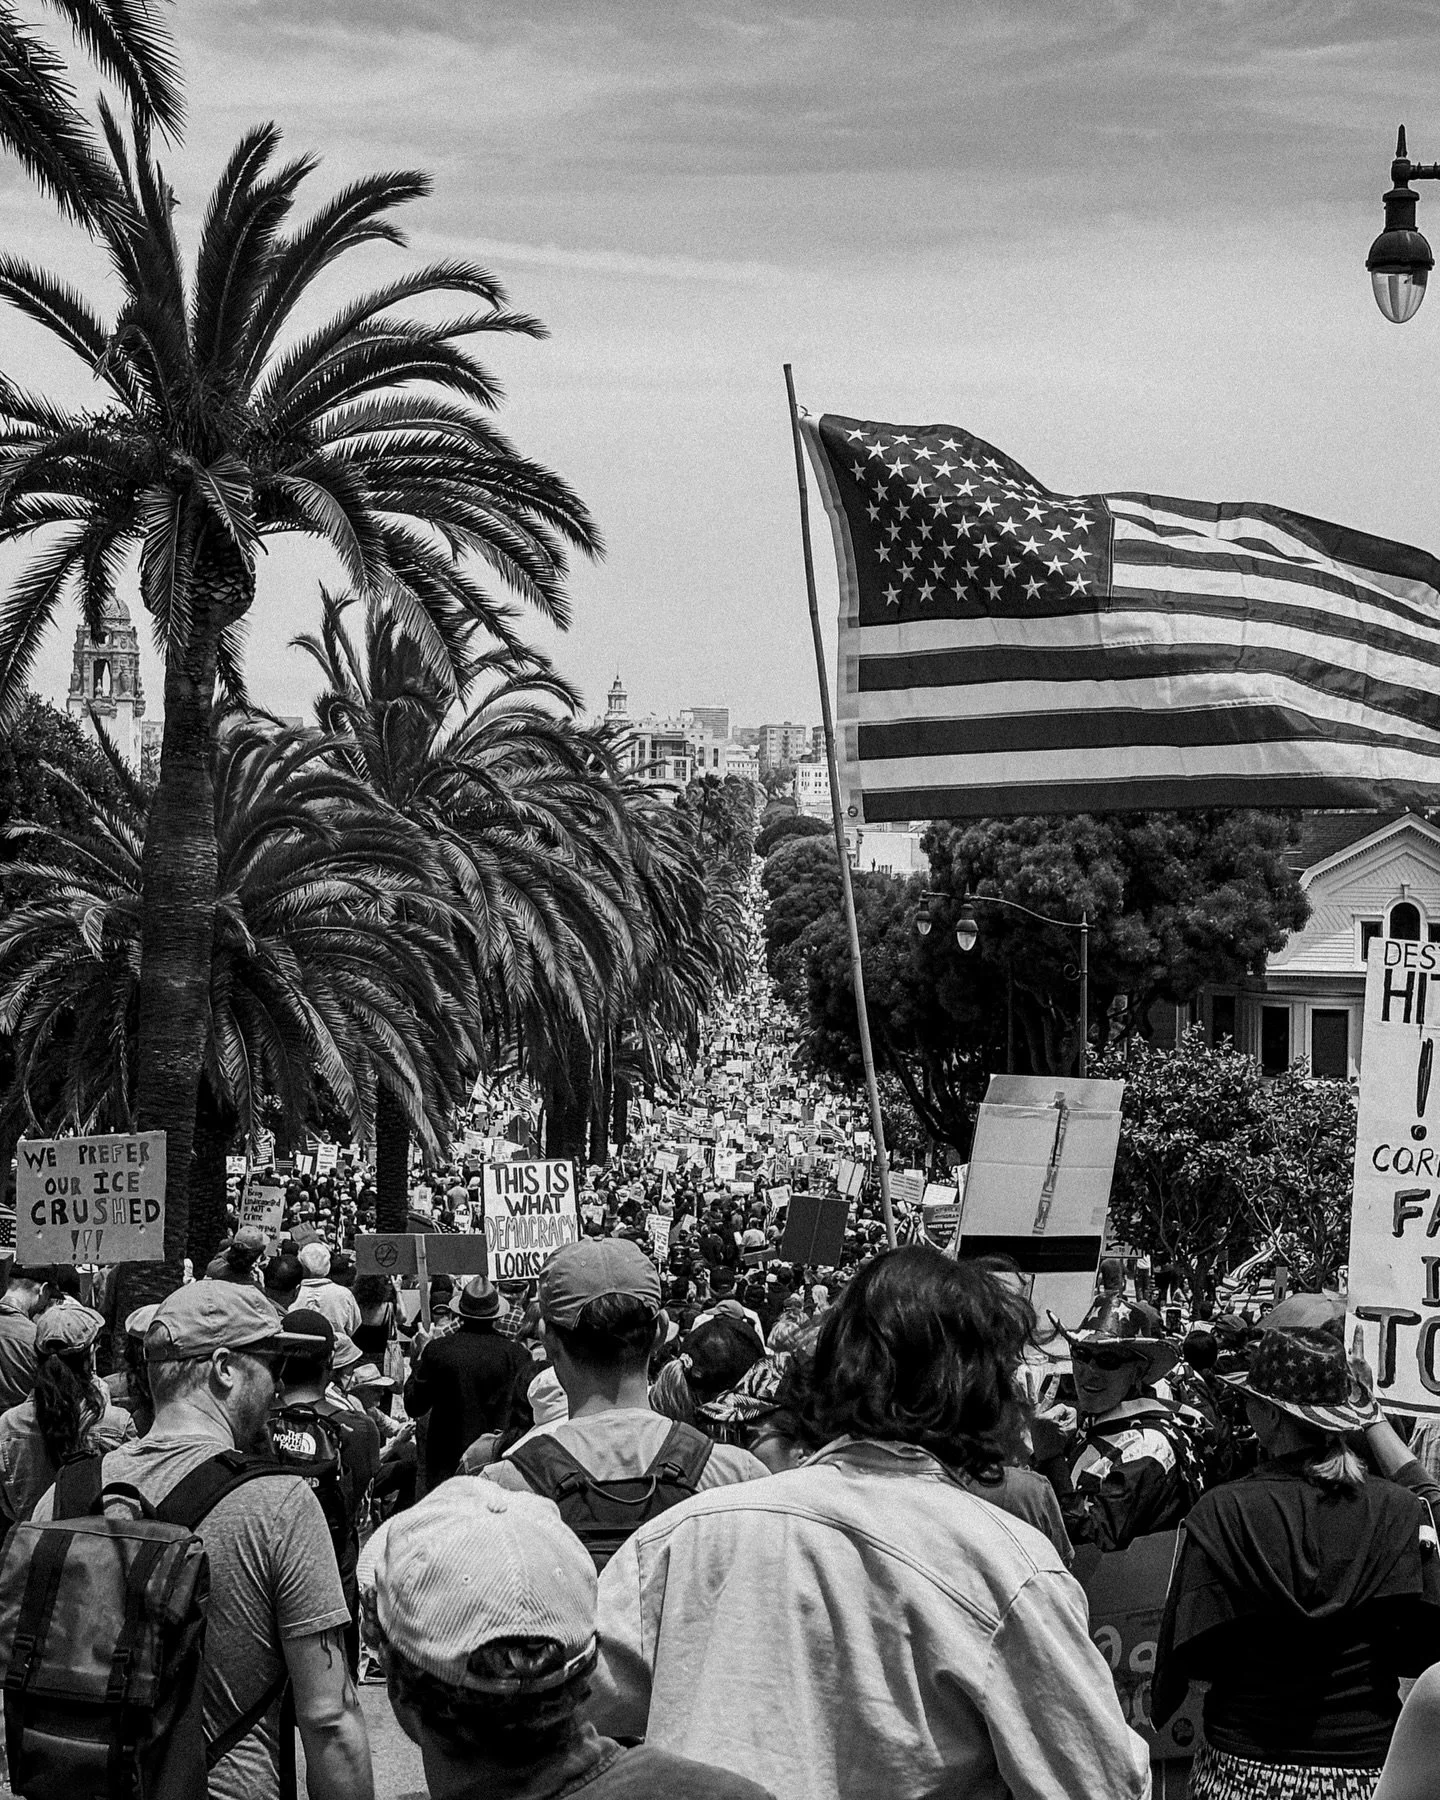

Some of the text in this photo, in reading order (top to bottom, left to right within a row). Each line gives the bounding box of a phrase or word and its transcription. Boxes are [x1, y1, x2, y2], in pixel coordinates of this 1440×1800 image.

[1384, 941, 1440, 970] DES
[23, 1141, 150, 1172] WE PREFER
[1372, 1143, 1440, 1177] COR
[44, 1170, 140, 1196] OUR ICE
[489, 1162, 570, 1195] THIS IS
[30, 1198, 161, 1226] CRUSHED
[504, 1193, 565, 1217] WHAT
[71, 1229, 104, 1261] !!!
[484, 1214, 578, 1253] DEMOCRACY
[495, 1251, 541, 1280] LOOKS
